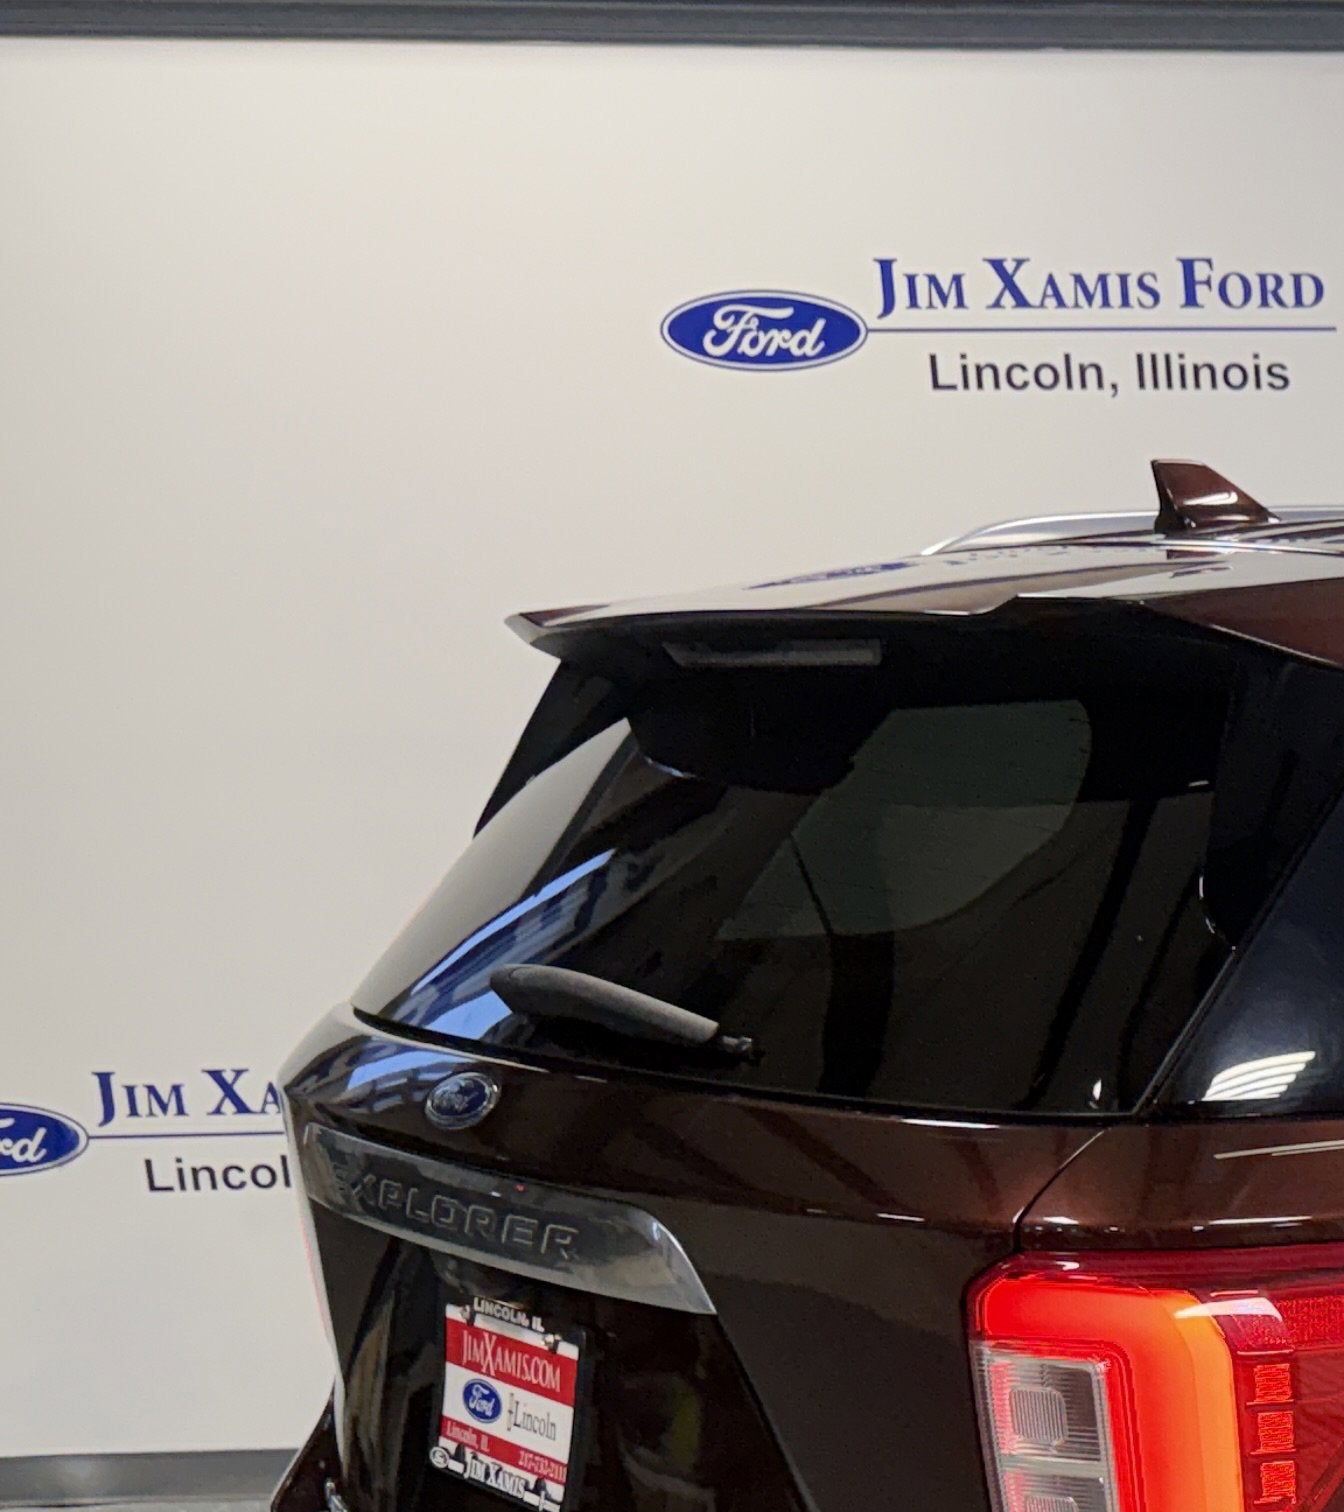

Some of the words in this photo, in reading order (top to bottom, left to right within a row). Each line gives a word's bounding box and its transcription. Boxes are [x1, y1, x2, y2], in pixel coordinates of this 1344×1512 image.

[872, 257, 969, 319] JIM
[981, 257, 1161, 310] XAMIS
[1175, 257, 1325, 310] FORD
[702, 303, 826, 363] Ford
[928, 352, 1119, 399] Lincoln,
[1135, 352, 1291, 392] Illinois
[90, 1070, 190, 1128] JIM
[143, 1154, 292, 1193] Lincol
[513, 1400, 557, 1441] Lincoln
